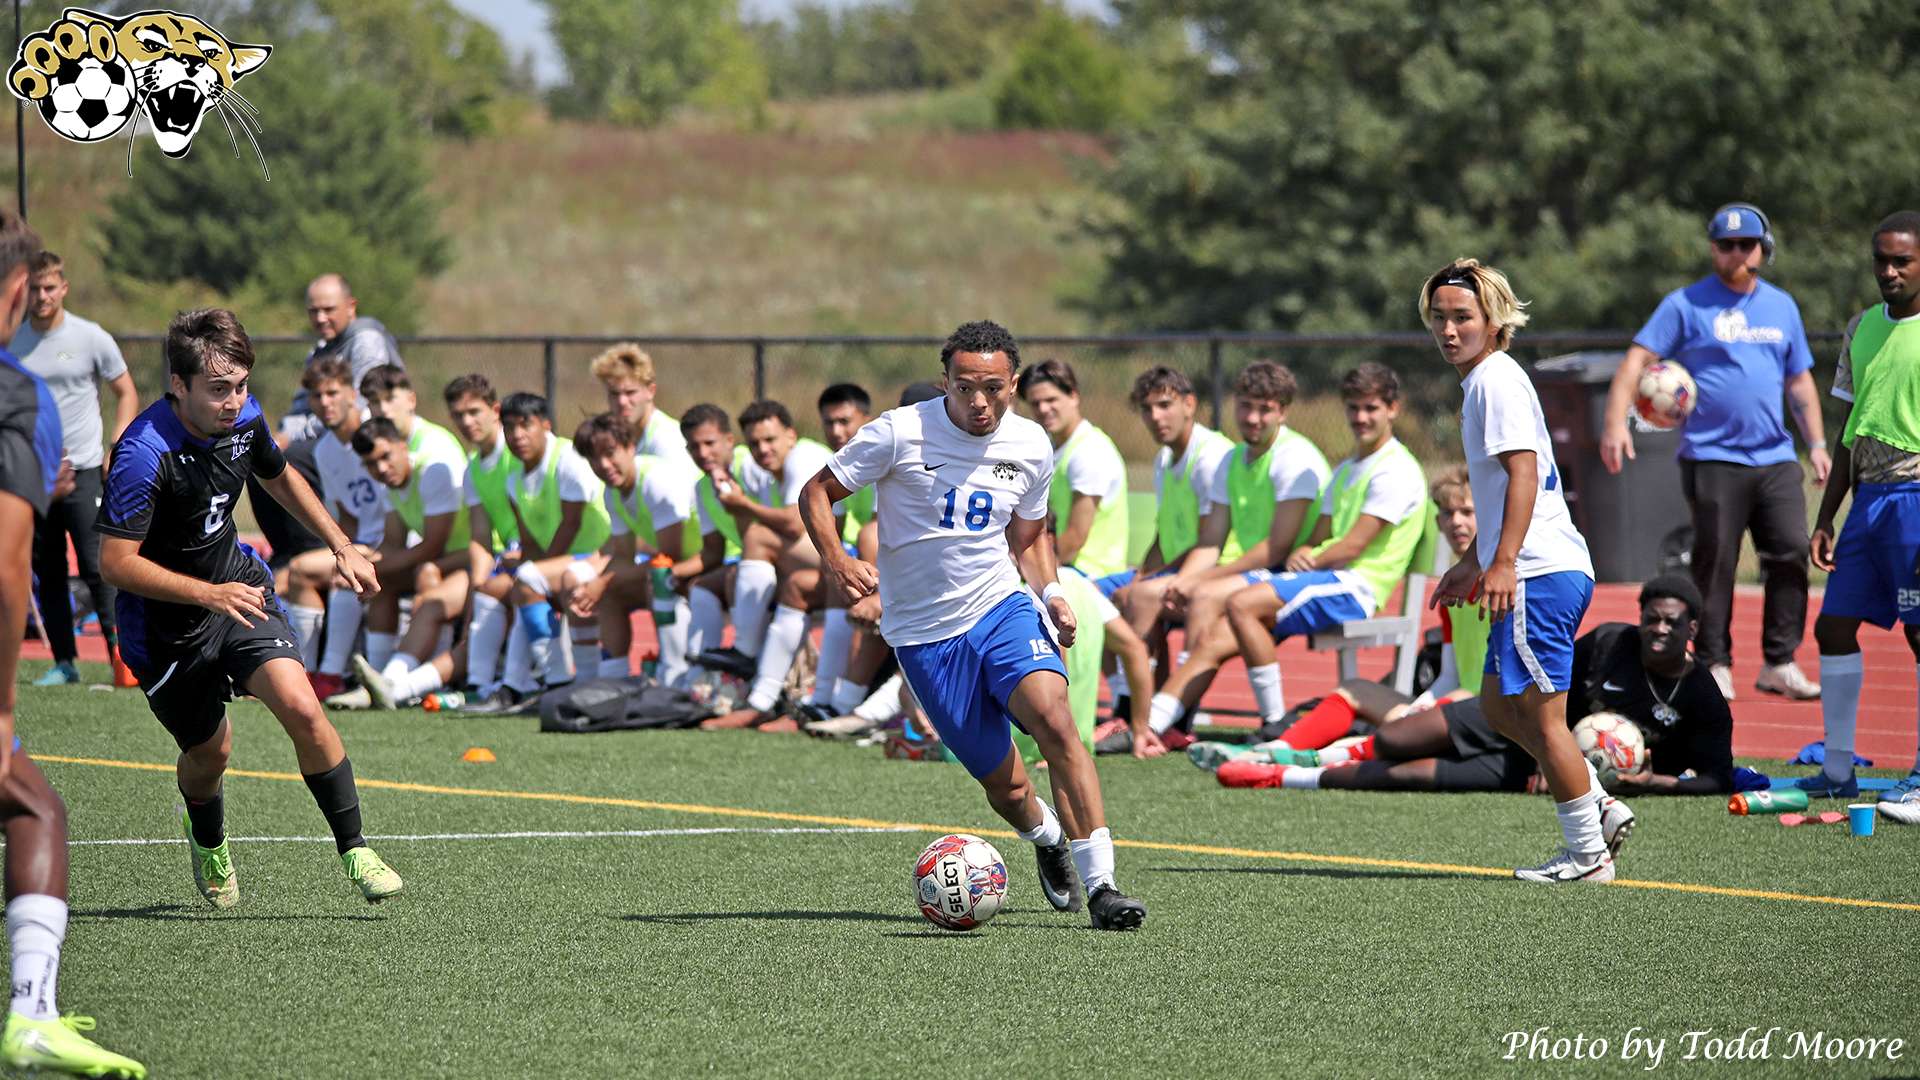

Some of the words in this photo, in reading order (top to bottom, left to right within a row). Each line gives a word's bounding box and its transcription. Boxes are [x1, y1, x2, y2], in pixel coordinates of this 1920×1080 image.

[204, 493, 230, 534] 6
[938, 486, 993, 531] 18
[1897, 588, 1920, 606] 25
[943, 861, 965, 913] SELECT
